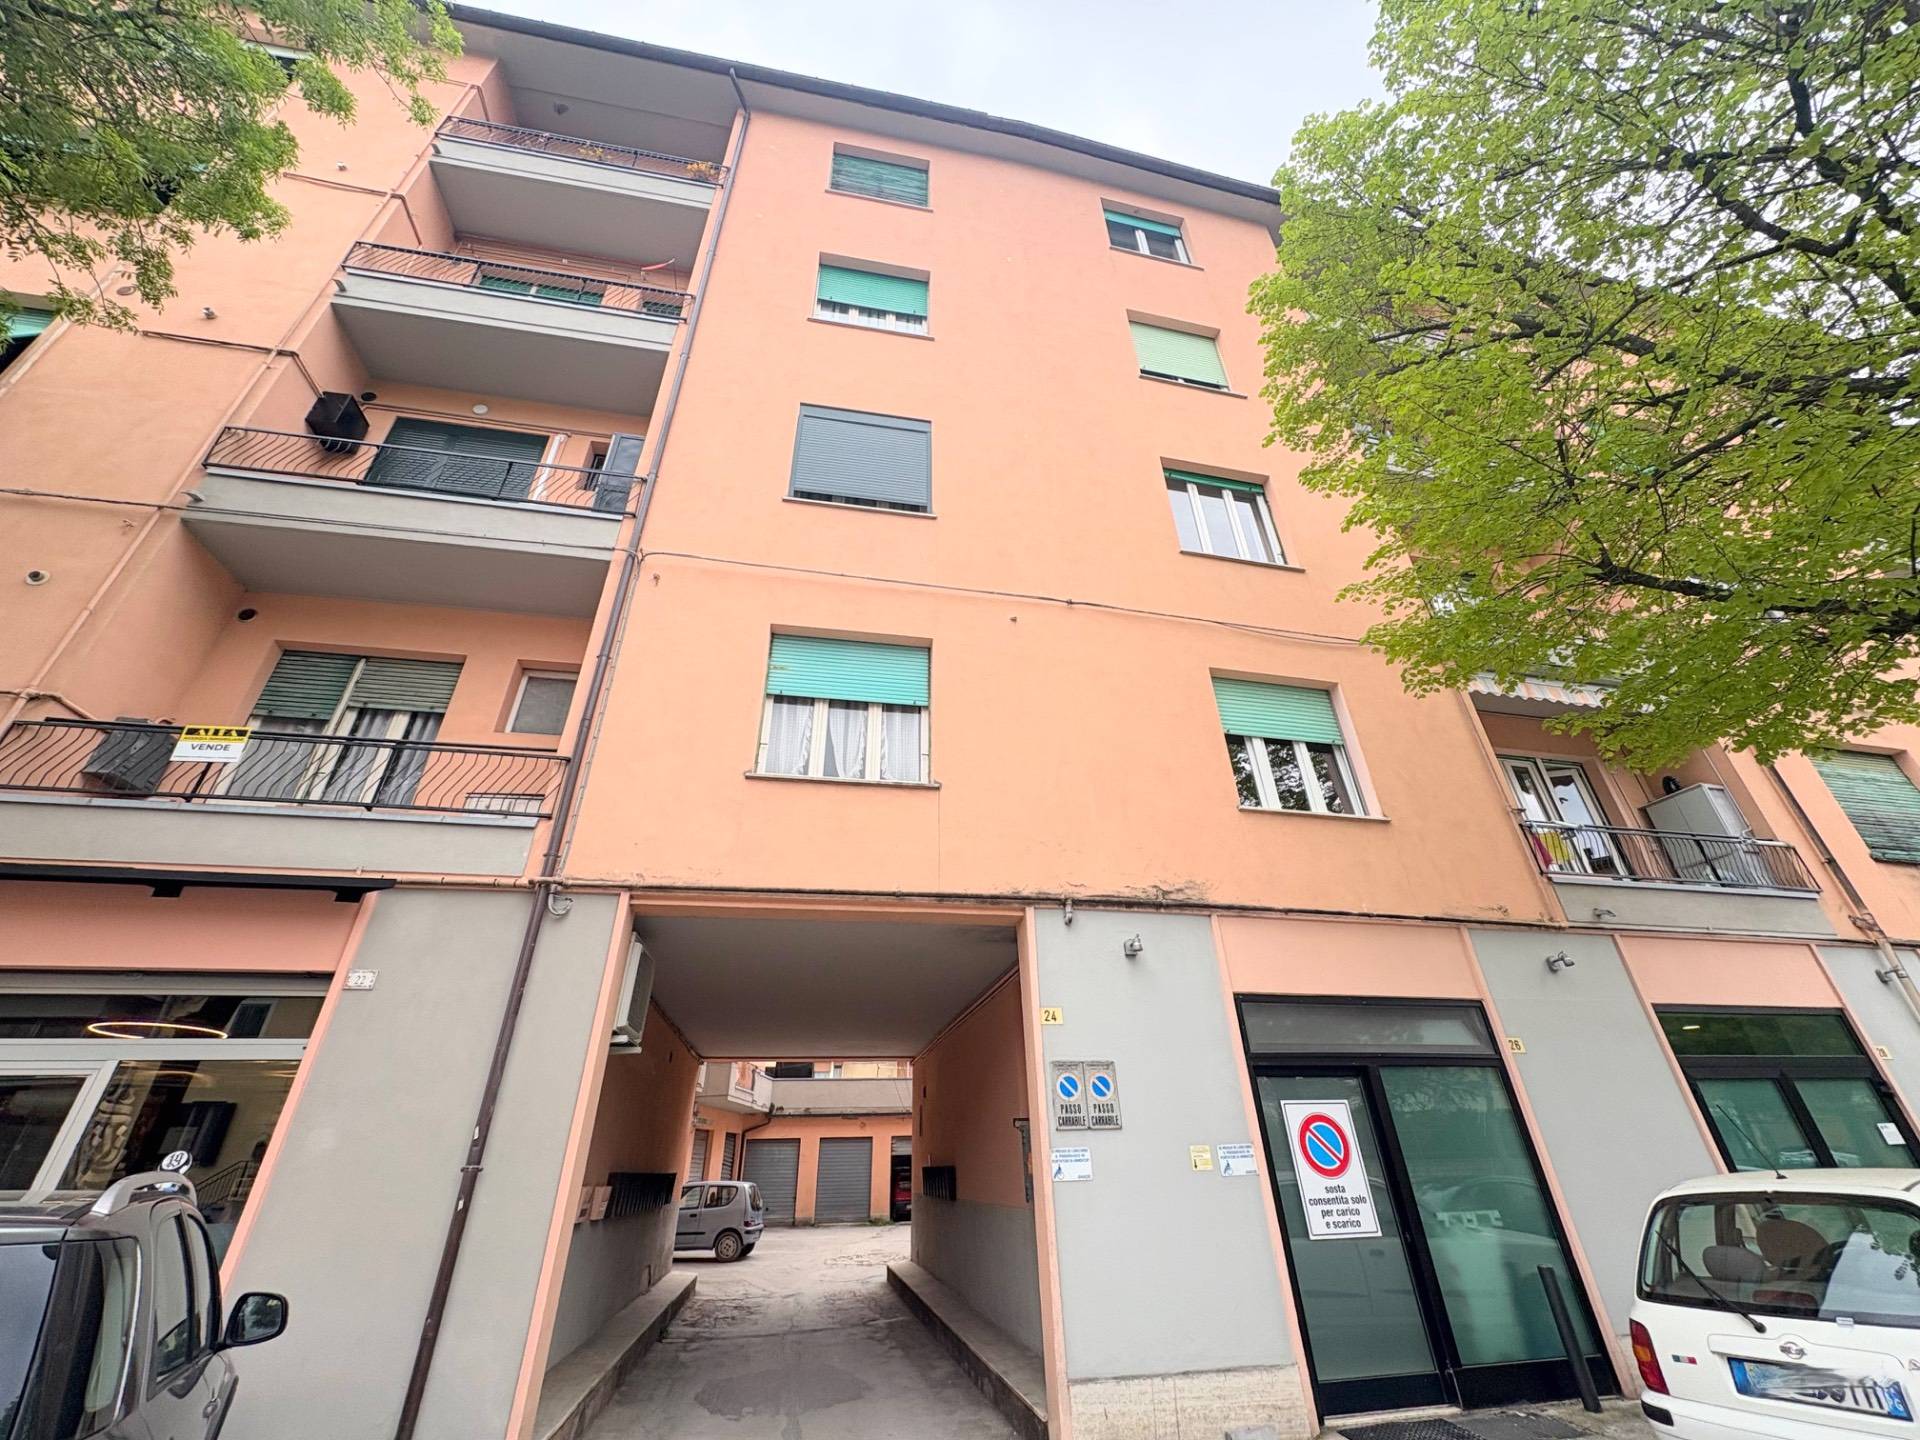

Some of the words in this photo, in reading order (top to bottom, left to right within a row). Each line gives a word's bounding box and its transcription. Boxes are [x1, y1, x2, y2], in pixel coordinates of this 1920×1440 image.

[1044, 1010, 1057, 1022] 24
[1508, 1040, 1521, 1051] 26
[1061, 1104, 1081, 1114] PASSO
[1093, 1103, 1114, 1113] PASSO
[1058, 1116, 1086, 1126] CARRABILE
[1091, 1115, 1119, 1126] CARRABILE
[1325, 1184, 1346, 1193] sosta
[1309, 1195, 1349, 1206] consentita
[1351, 1195, 1367, 1204] solo
[1321, 1209, 1334, 1219] per
[1336, 1207, 1360, 1216] carico
[1325, 1221, 1331, 1229] e
[1332, 1218, 1361, 1228] scarico
